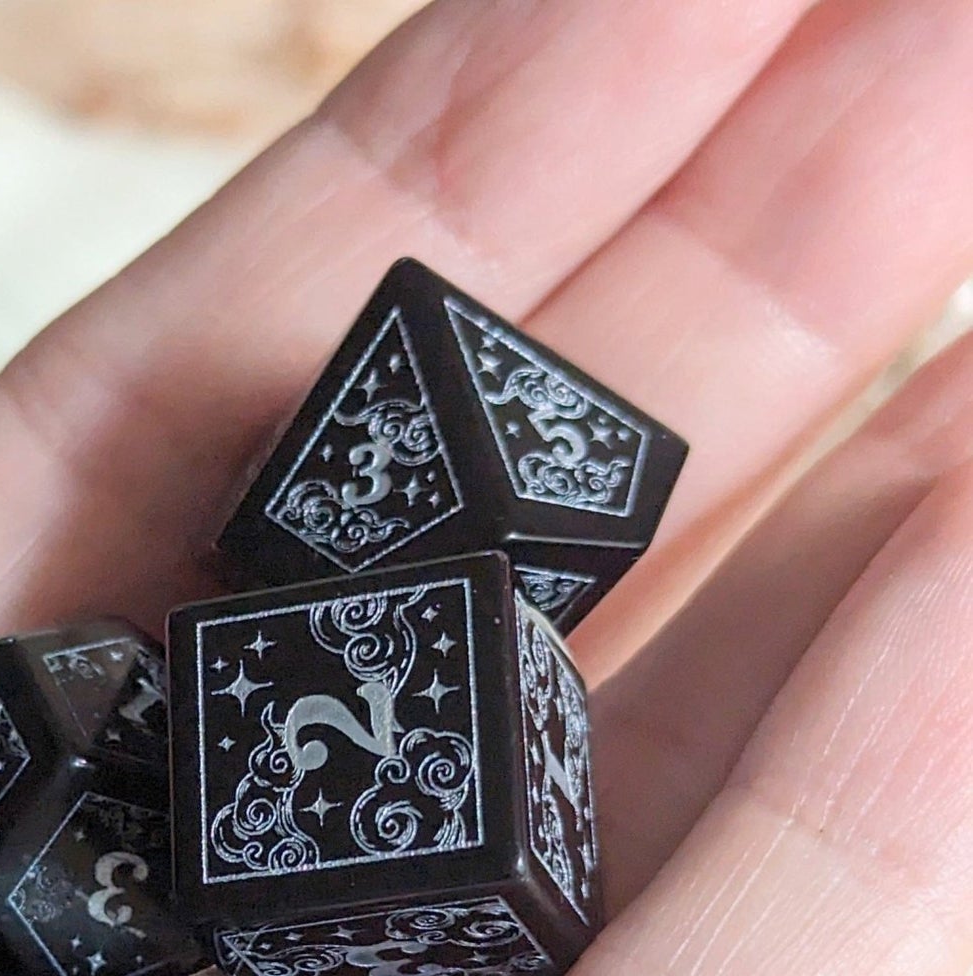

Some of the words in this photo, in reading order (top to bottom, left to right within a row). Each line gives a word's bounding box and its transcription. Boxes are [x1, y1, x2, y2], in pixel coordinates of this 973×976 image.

[527, 408, 588, 466] 5
[341, 443, 393, 504] 3
[285, 681, 396, 770] 2
[88, 852, 149, 927] 3
